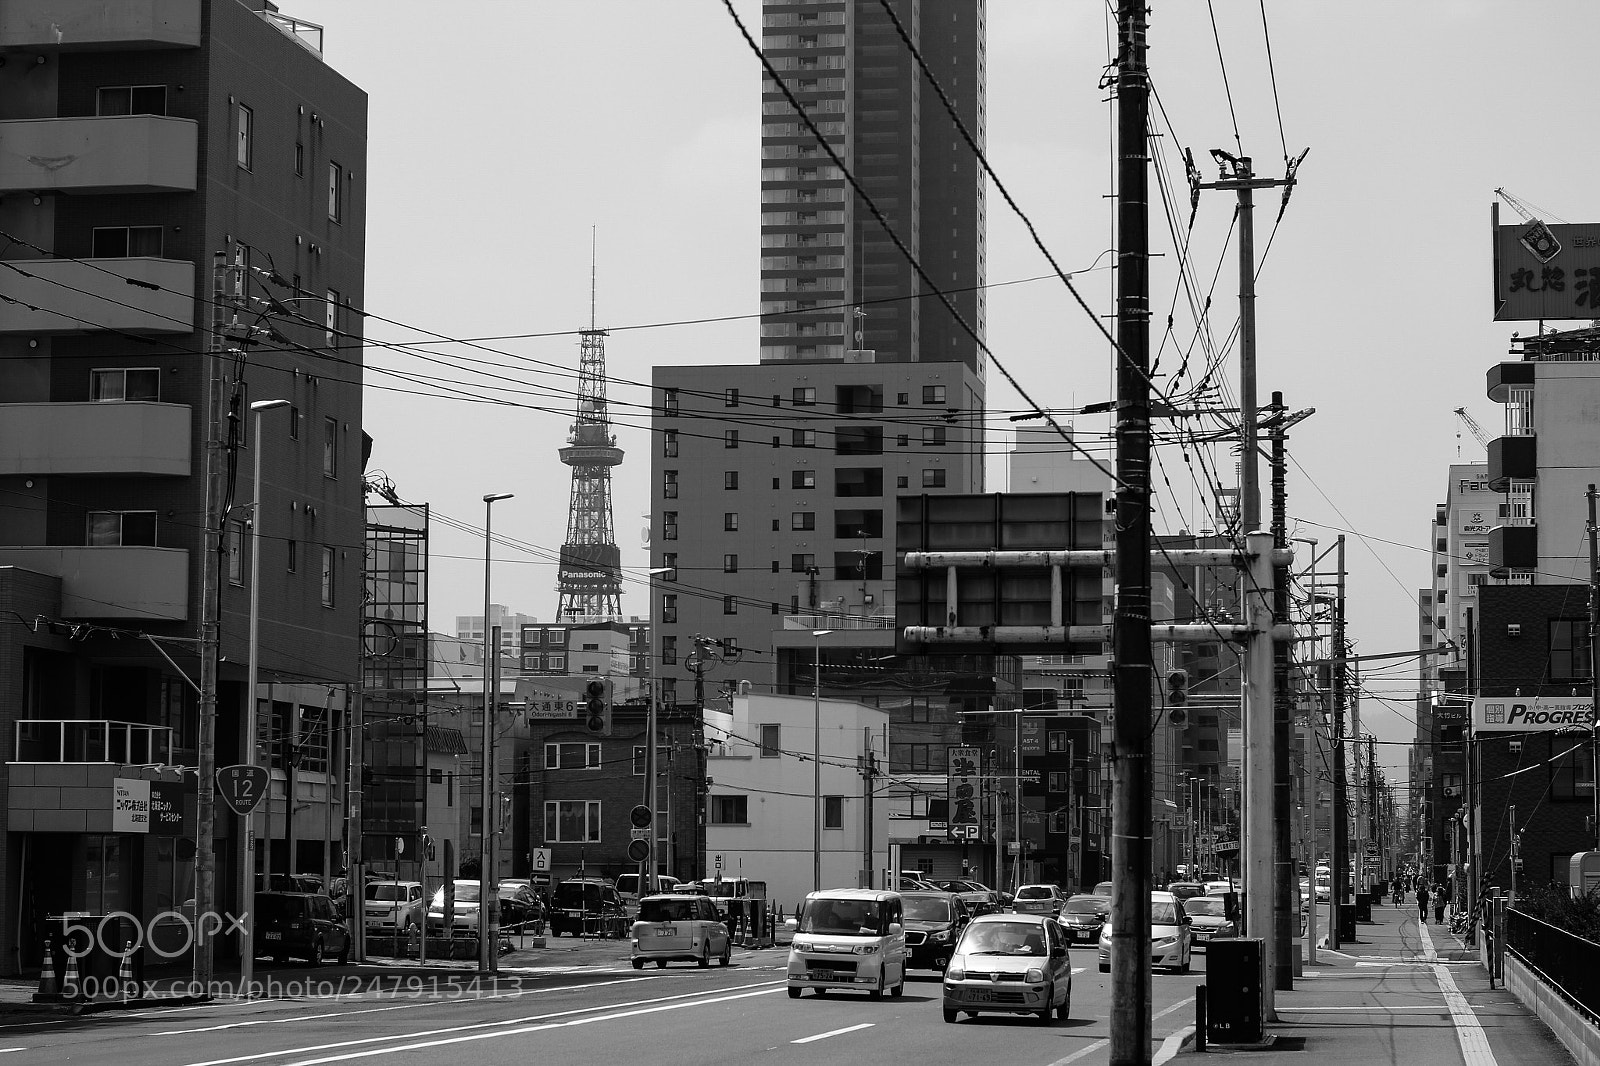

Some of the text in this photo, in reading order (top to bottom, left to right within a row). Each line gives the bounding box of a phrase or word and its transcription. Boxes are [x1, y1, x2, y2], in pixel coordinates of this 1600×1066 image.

[561, 570, 606, 579] Panasonic
[529, 701, 574, 712] 大通東6
[232, 779, 254, 798] 12
[968, 827, 978, 838] P
[536, 851, 546, 869] 入口
[715, 854, 722, 869] 出口
